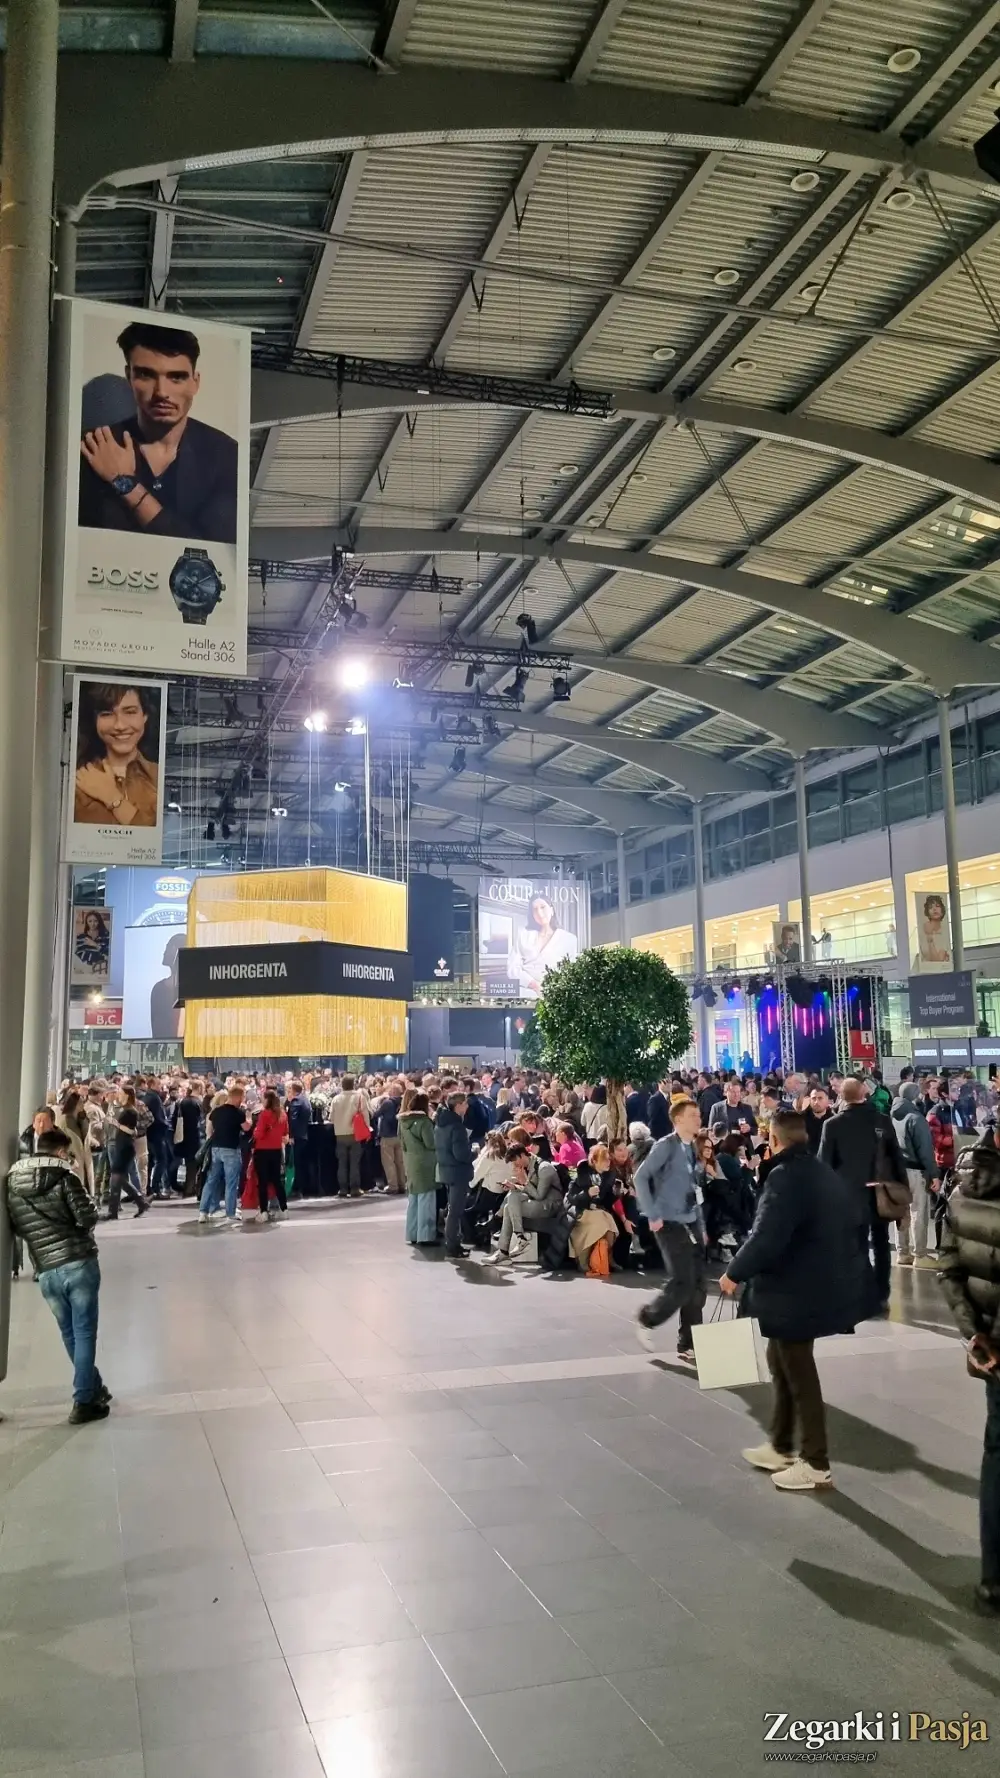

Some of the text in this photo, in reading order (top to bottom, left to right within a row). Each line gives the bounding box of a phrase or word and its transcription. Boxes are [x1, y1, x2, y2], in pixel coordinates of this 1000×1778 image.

[87, 566, 160, 590] BOSS
[73, 639, 155, 651] MOVADO GROUP
[188, 637, 236, 652] Halle A2
[180, 649, 236, 663] Stand 306
[155, 882, 191, 891] FOSSIL
[544, 885, 580, 904] LION
[209, 962, 288, 980] INHORGENTA
[342, 963, 395, 982] INHORGENTA
[925, 992, 956, 1003] International
[919, 1005, 965, 1017] Top Buyer Program
